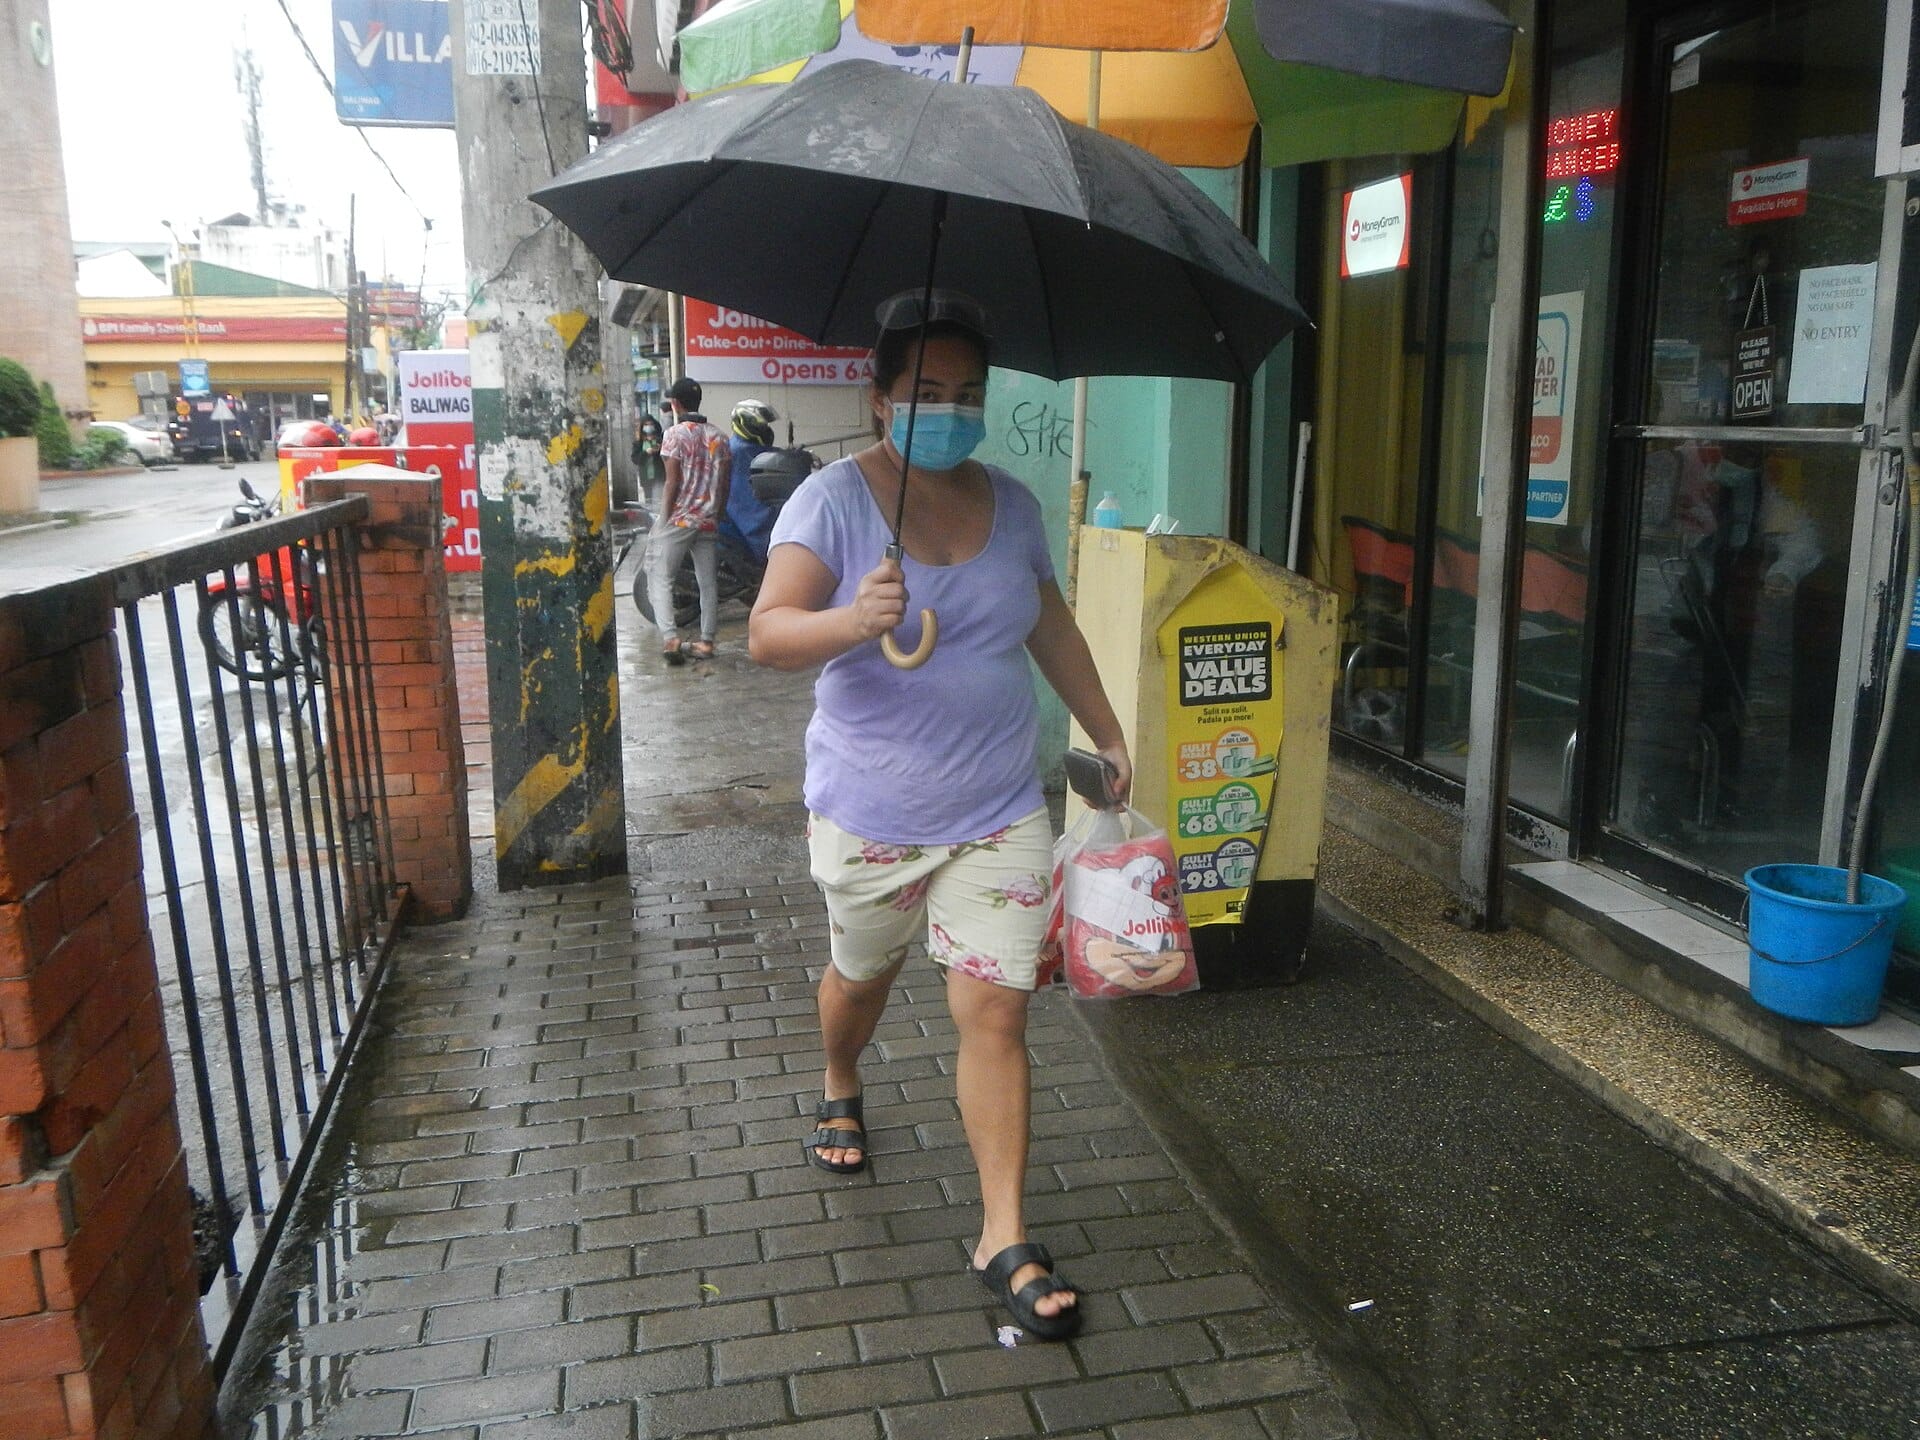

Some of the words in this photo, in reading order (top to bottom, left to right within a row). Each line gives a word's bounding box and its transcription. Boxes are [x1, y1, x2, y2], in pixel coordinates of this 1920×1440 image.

[1547, 109, 1615, 145] ONEY
[1361, 215, 1401, 234] MoneyGram
[198, 321, 226, 334] Bank
[1801, 326, 1819, 341] NO
[1821, 325, 1861, 340] ENTRY
[697, 335, 764, 350] Take-Out
[1741, 336, 1769, 350] PLEASE
[1738, 348, 1759, 361] COME
[1761, 346, 1770, 357] IN
[761, 357, 837, 384] Opens
[1735, 379, 1771, 409] OPEN
[410, 397, 470, 415] BALIWAG
[1530, 491, 1563, 505] PARTNER
[1184, 634, 1231, 644] WESTERN
[1235, 631, 1267, 641] UNION
[1183, 640, 1266, 657] EVERYDAY
[1184, 657, 1266, 680] VALUE
[1185, 675, 1267, 698] DEALS
[1203, 707, 1220, 716] Sulit
[1197, 715, 1222, 724] Padala
[1223, 715, 1233, 723] pa
[1182, 798, 1213, 809] SULIT
[1182, 854, 1213, 865] SULIT
[1182, 862, 1213, 872] PADALA
